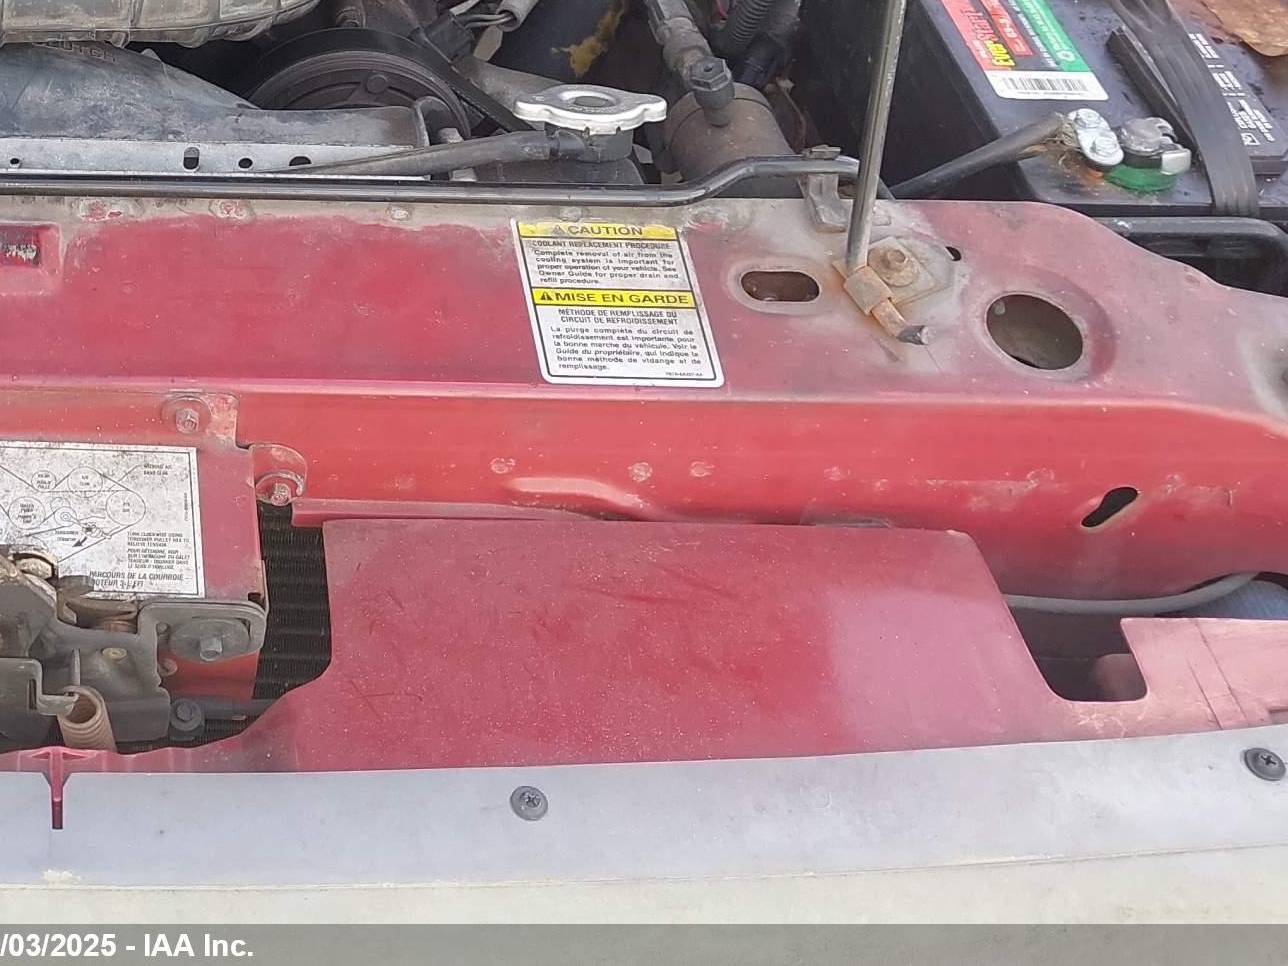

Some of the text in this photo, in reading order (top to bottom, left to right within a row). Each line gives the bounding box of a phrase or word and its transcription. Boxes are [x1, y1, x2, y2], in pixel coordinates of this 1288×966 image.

[567, 225, 643, 235] CAUTION
[554, 292, 689, 303] MISE EN GARDE
[558, 363, 610, 371] remplissage.
[89, 569, 125, 580] PARCOURS
[148, 571, 184, 581] COURROIE
[93, 577, 117, 587] OTEUR
